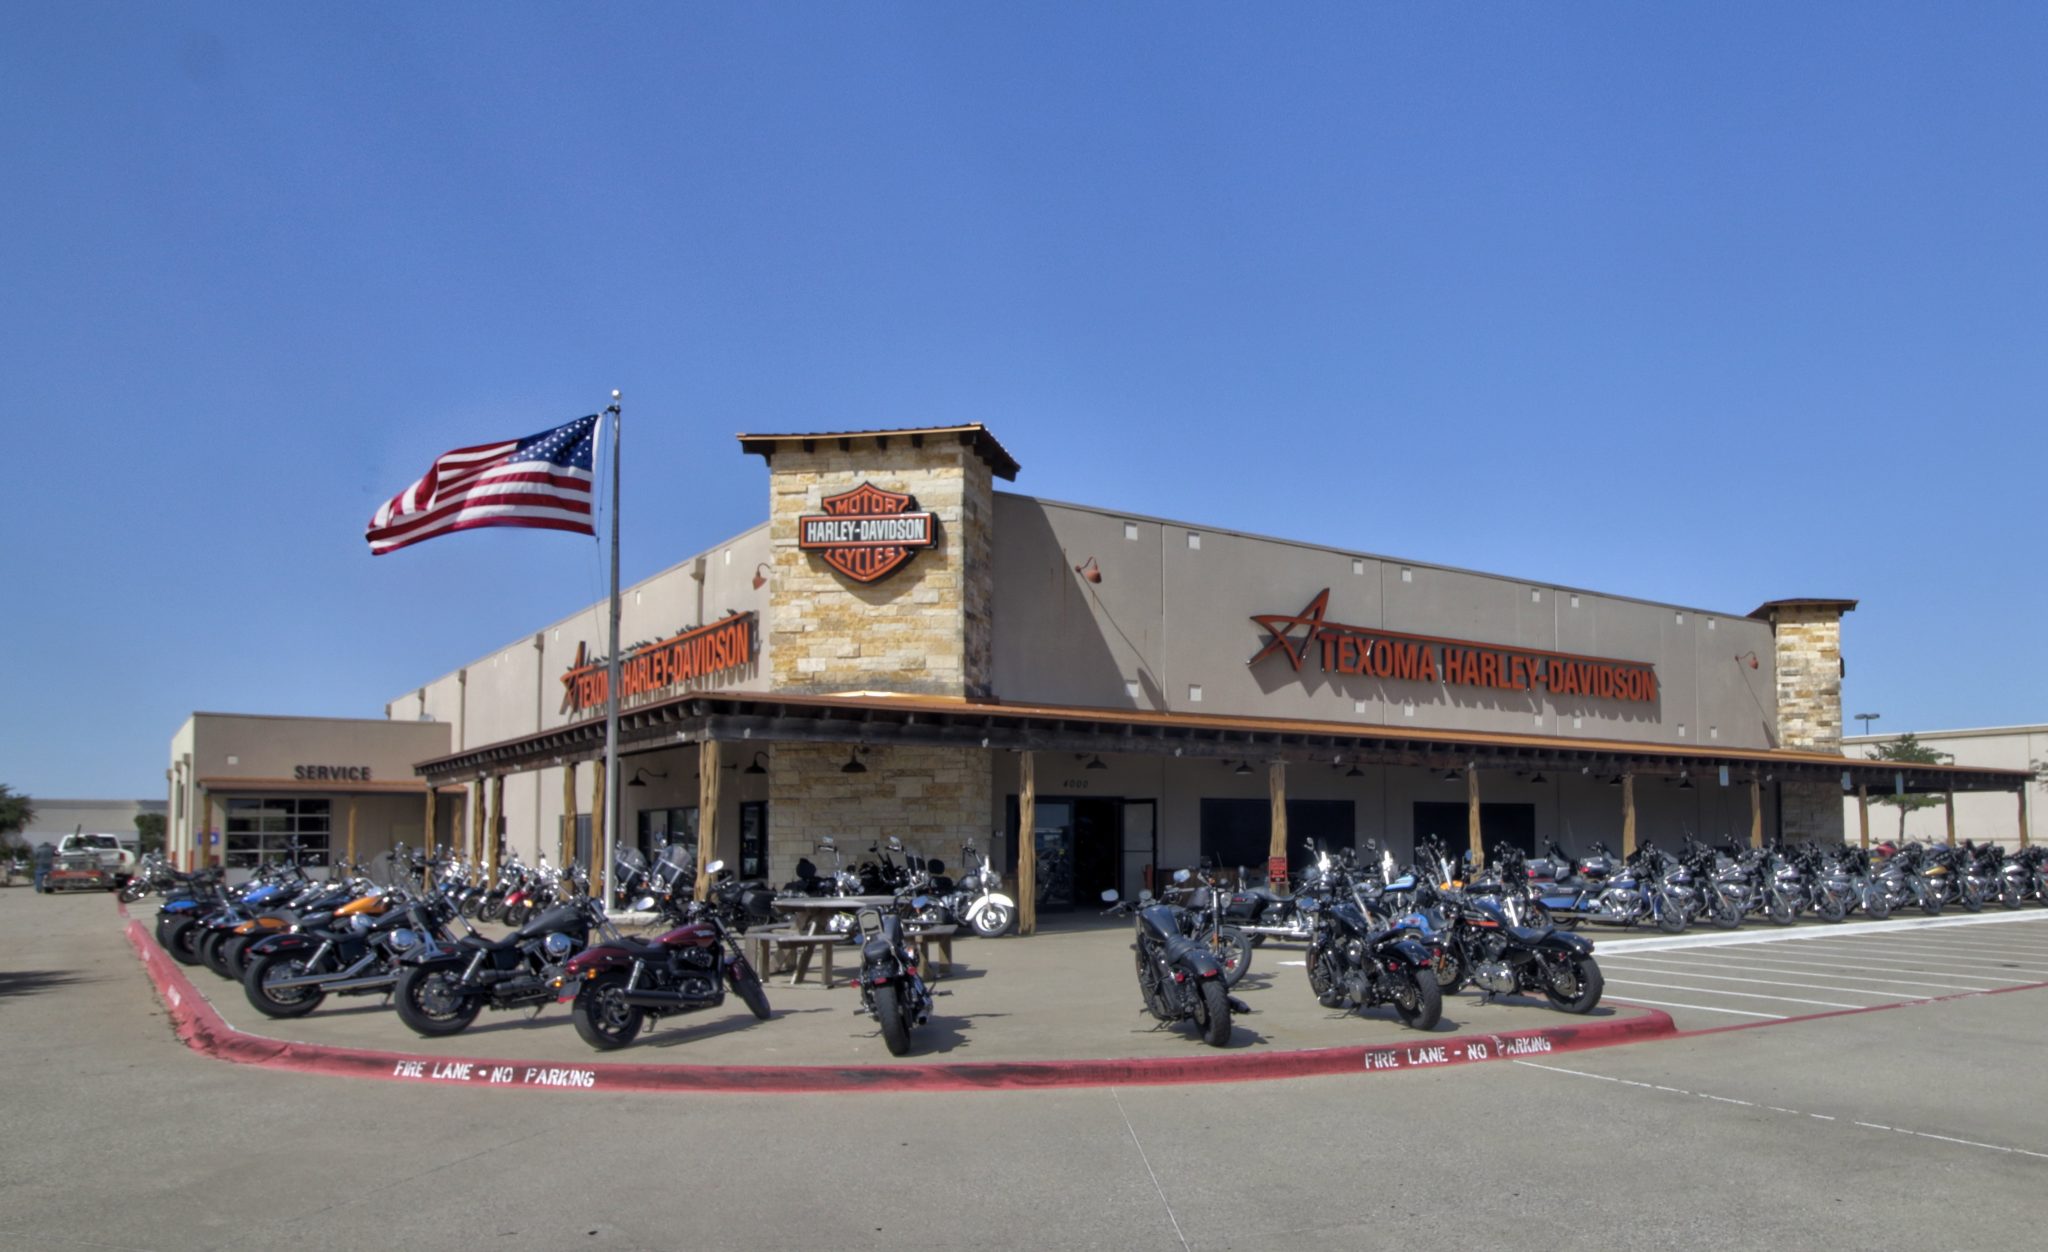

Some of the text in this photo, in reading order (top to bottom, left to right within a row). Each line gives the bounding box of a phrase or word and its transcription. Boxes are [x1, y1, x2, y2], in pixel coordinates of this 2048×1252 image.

[835, 491, 897, 514] MOTOR
[806, 518, 925, 543] HARLEY-DAVIDSON
[834, 547, 896, 576] CYCLES
[623, 622, 748, 697] HARLEY-DAVIDSON
[1317, 634, 1656, 701] TEXOMA HARLEY-DAVIDSON
[294, 765, 371, 781] SERVICE
[1364, 1050, 1399, 1069] FIRE
[1407, 1046, 1448, 1065] LANE
[1467, 1043, 1488, 1060] NO
[1492, 1034, 1552, 1056] PARKING
[393, 1060, 426, 1078] FIRE
[432, 1062, 473, 1080] LANE
[490, 1066, 514, 1083] NO
[524, 1068, 596, 1088] PARKING
